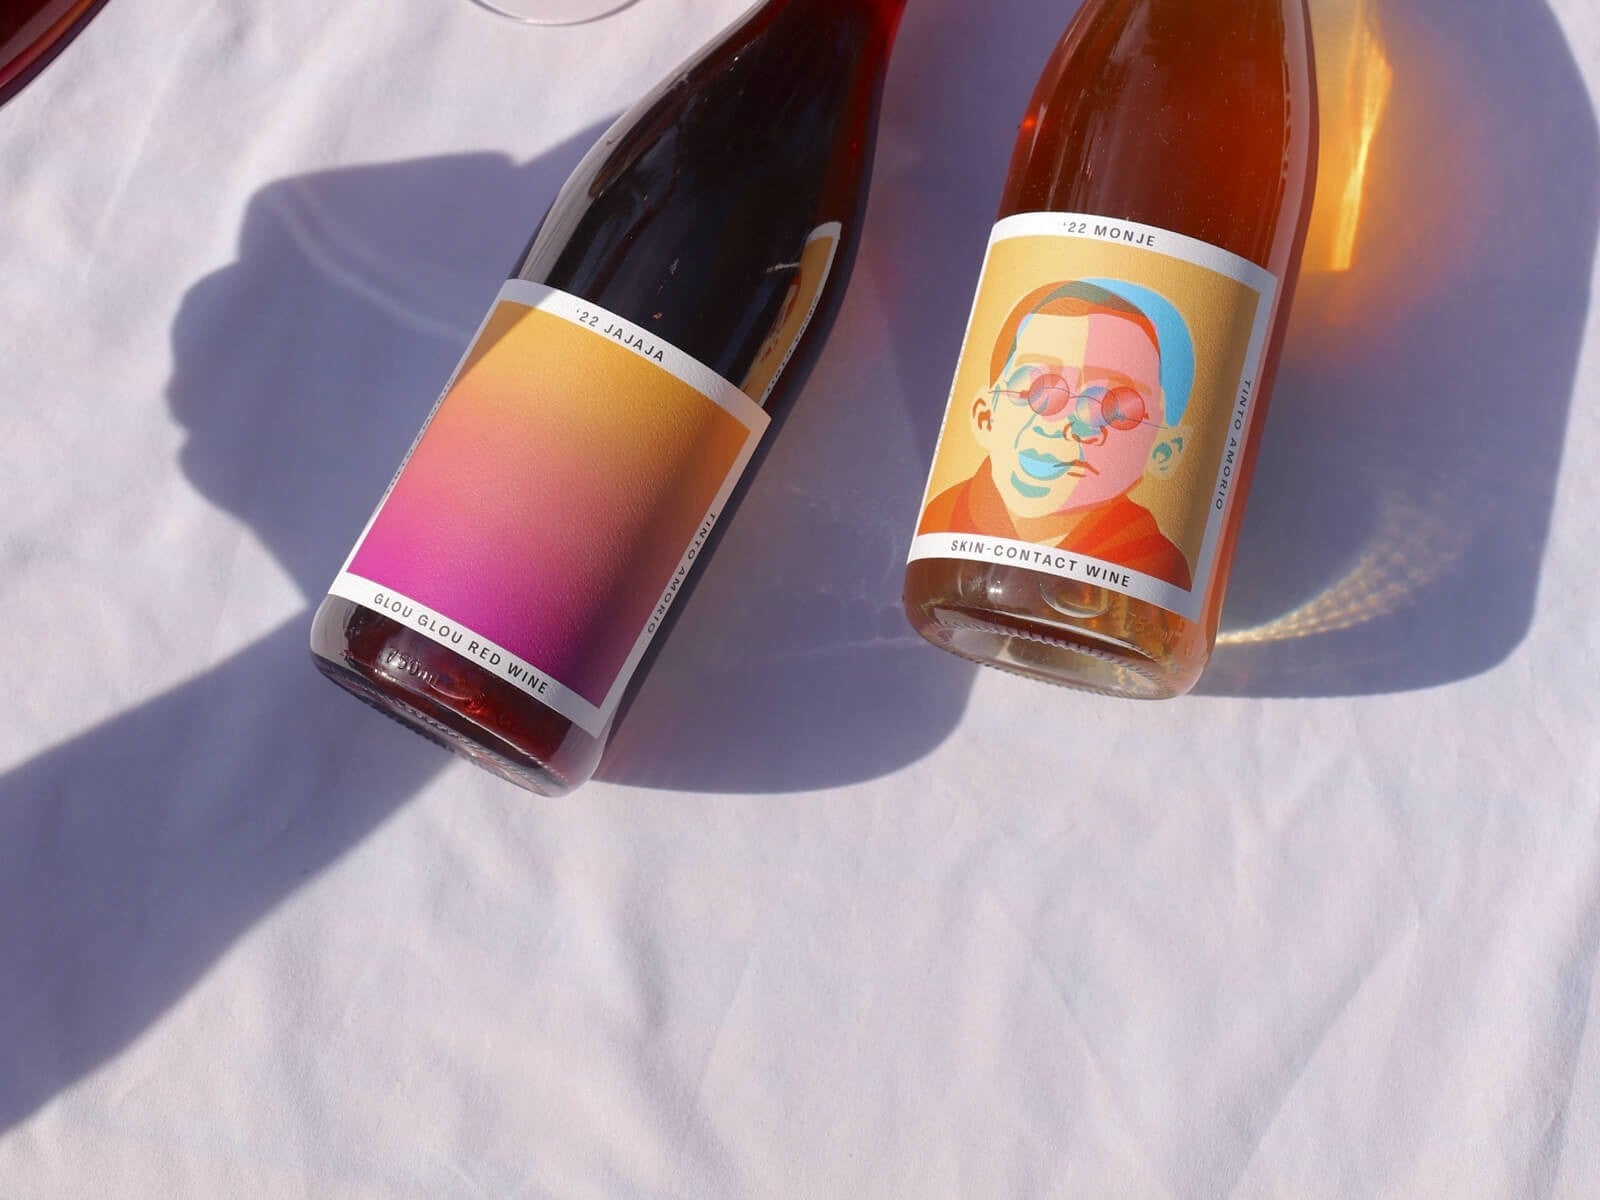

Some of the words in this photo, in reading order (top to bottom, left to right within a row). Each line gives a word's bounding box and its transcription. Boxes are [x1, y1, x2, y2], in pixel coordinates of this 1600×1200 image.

[1093, 224, 1156, 247] MONJE
[576, 308, 599, 327] '22
[603, 324, 664, 362] JAJAJA
[1234, 379, 1251, 431] TINTO
[1215, 437, 1238, 510] AMORIO
[688, 512, 717, 560] TINTO
[950, 539, 1079, 572] SKIN-CONTACT
[1086, 563, 1131, 588] WINE
[647, 567, 685, 633] AMORIO
[374, 593, 413, 618] GLOU
[417, 614, 463, 644] GLOU
[467, 640, 500, 666] RED
[507, 662, 549, 695] WINE
